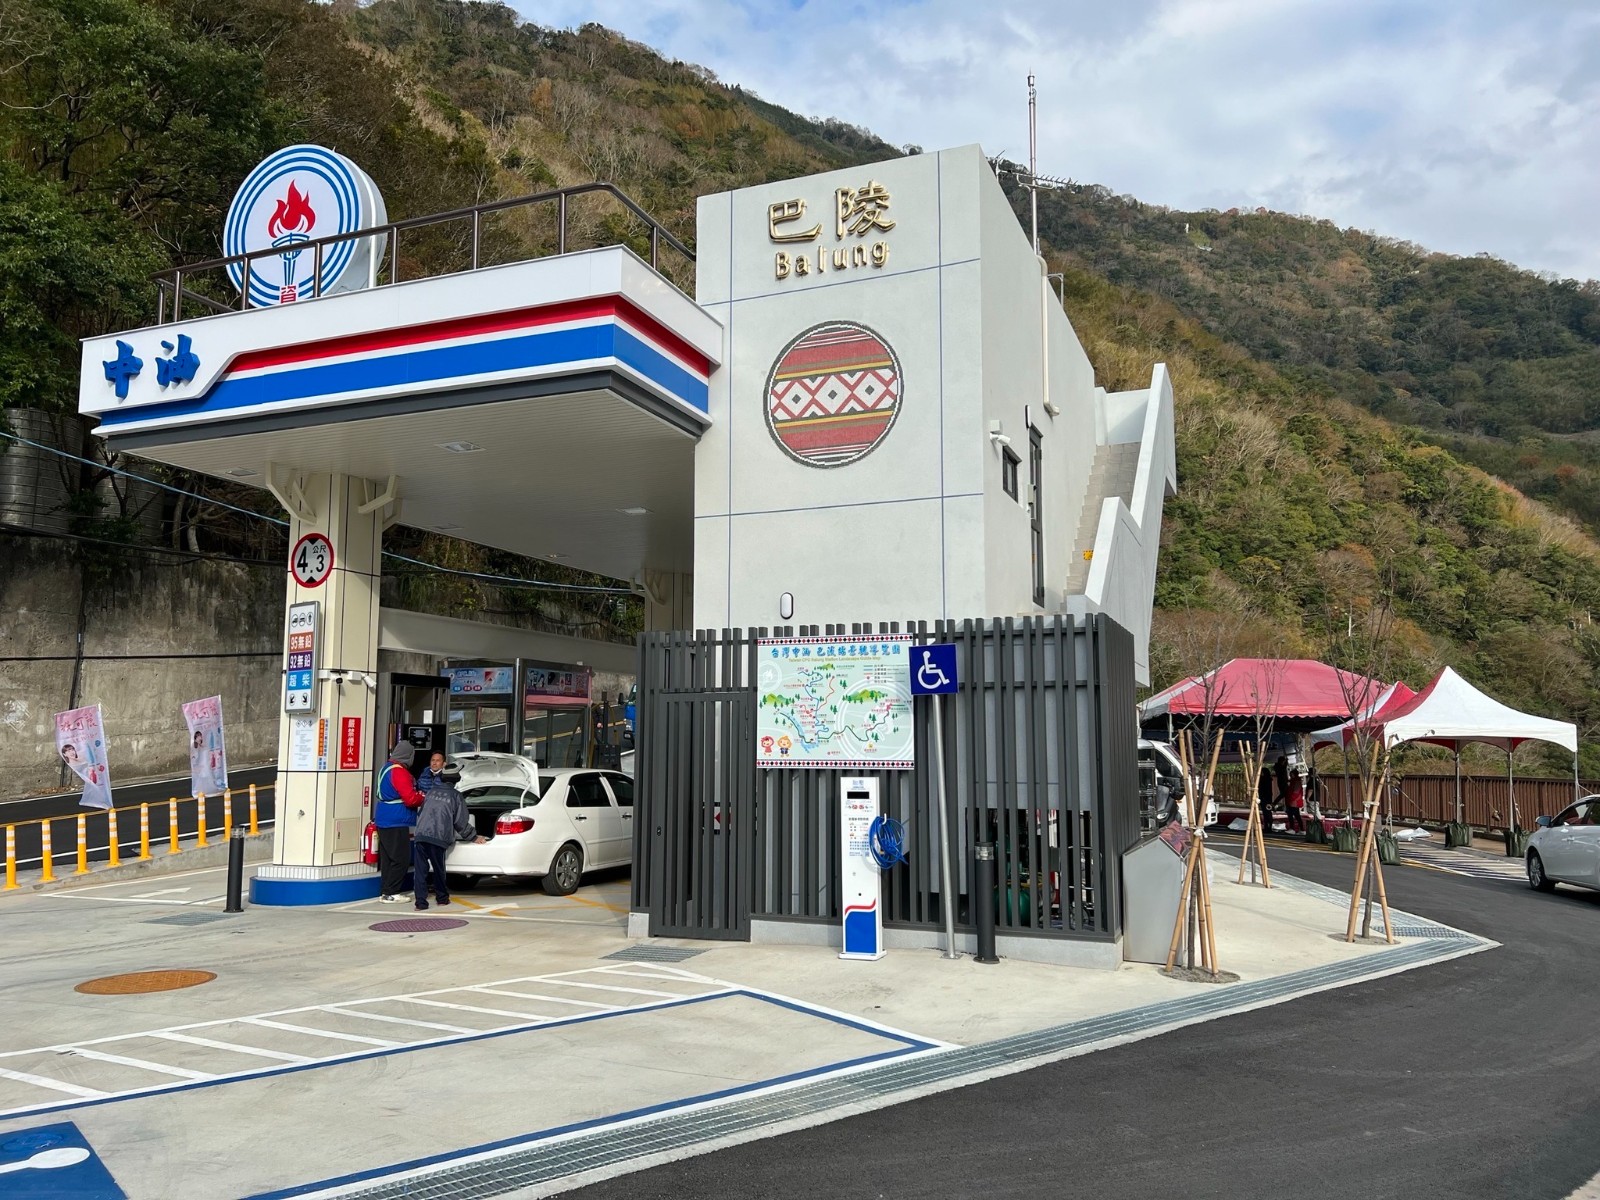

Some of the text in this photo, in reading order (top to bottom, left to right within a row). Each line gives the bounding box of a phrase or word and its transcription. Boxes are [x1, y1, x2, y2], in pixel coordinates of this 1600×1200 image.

[768, 180, 896, 241] 巴陵
[775, 242, 890, 280] Balung
[103, 334, 200, 399] 中油
[297, 546, 325, 573] 4.3
[312, 544, 327, 554] 公尺
[290, 634, 312, 650] 95無鉛
[289, 653, 311, 669] 92無鉛
